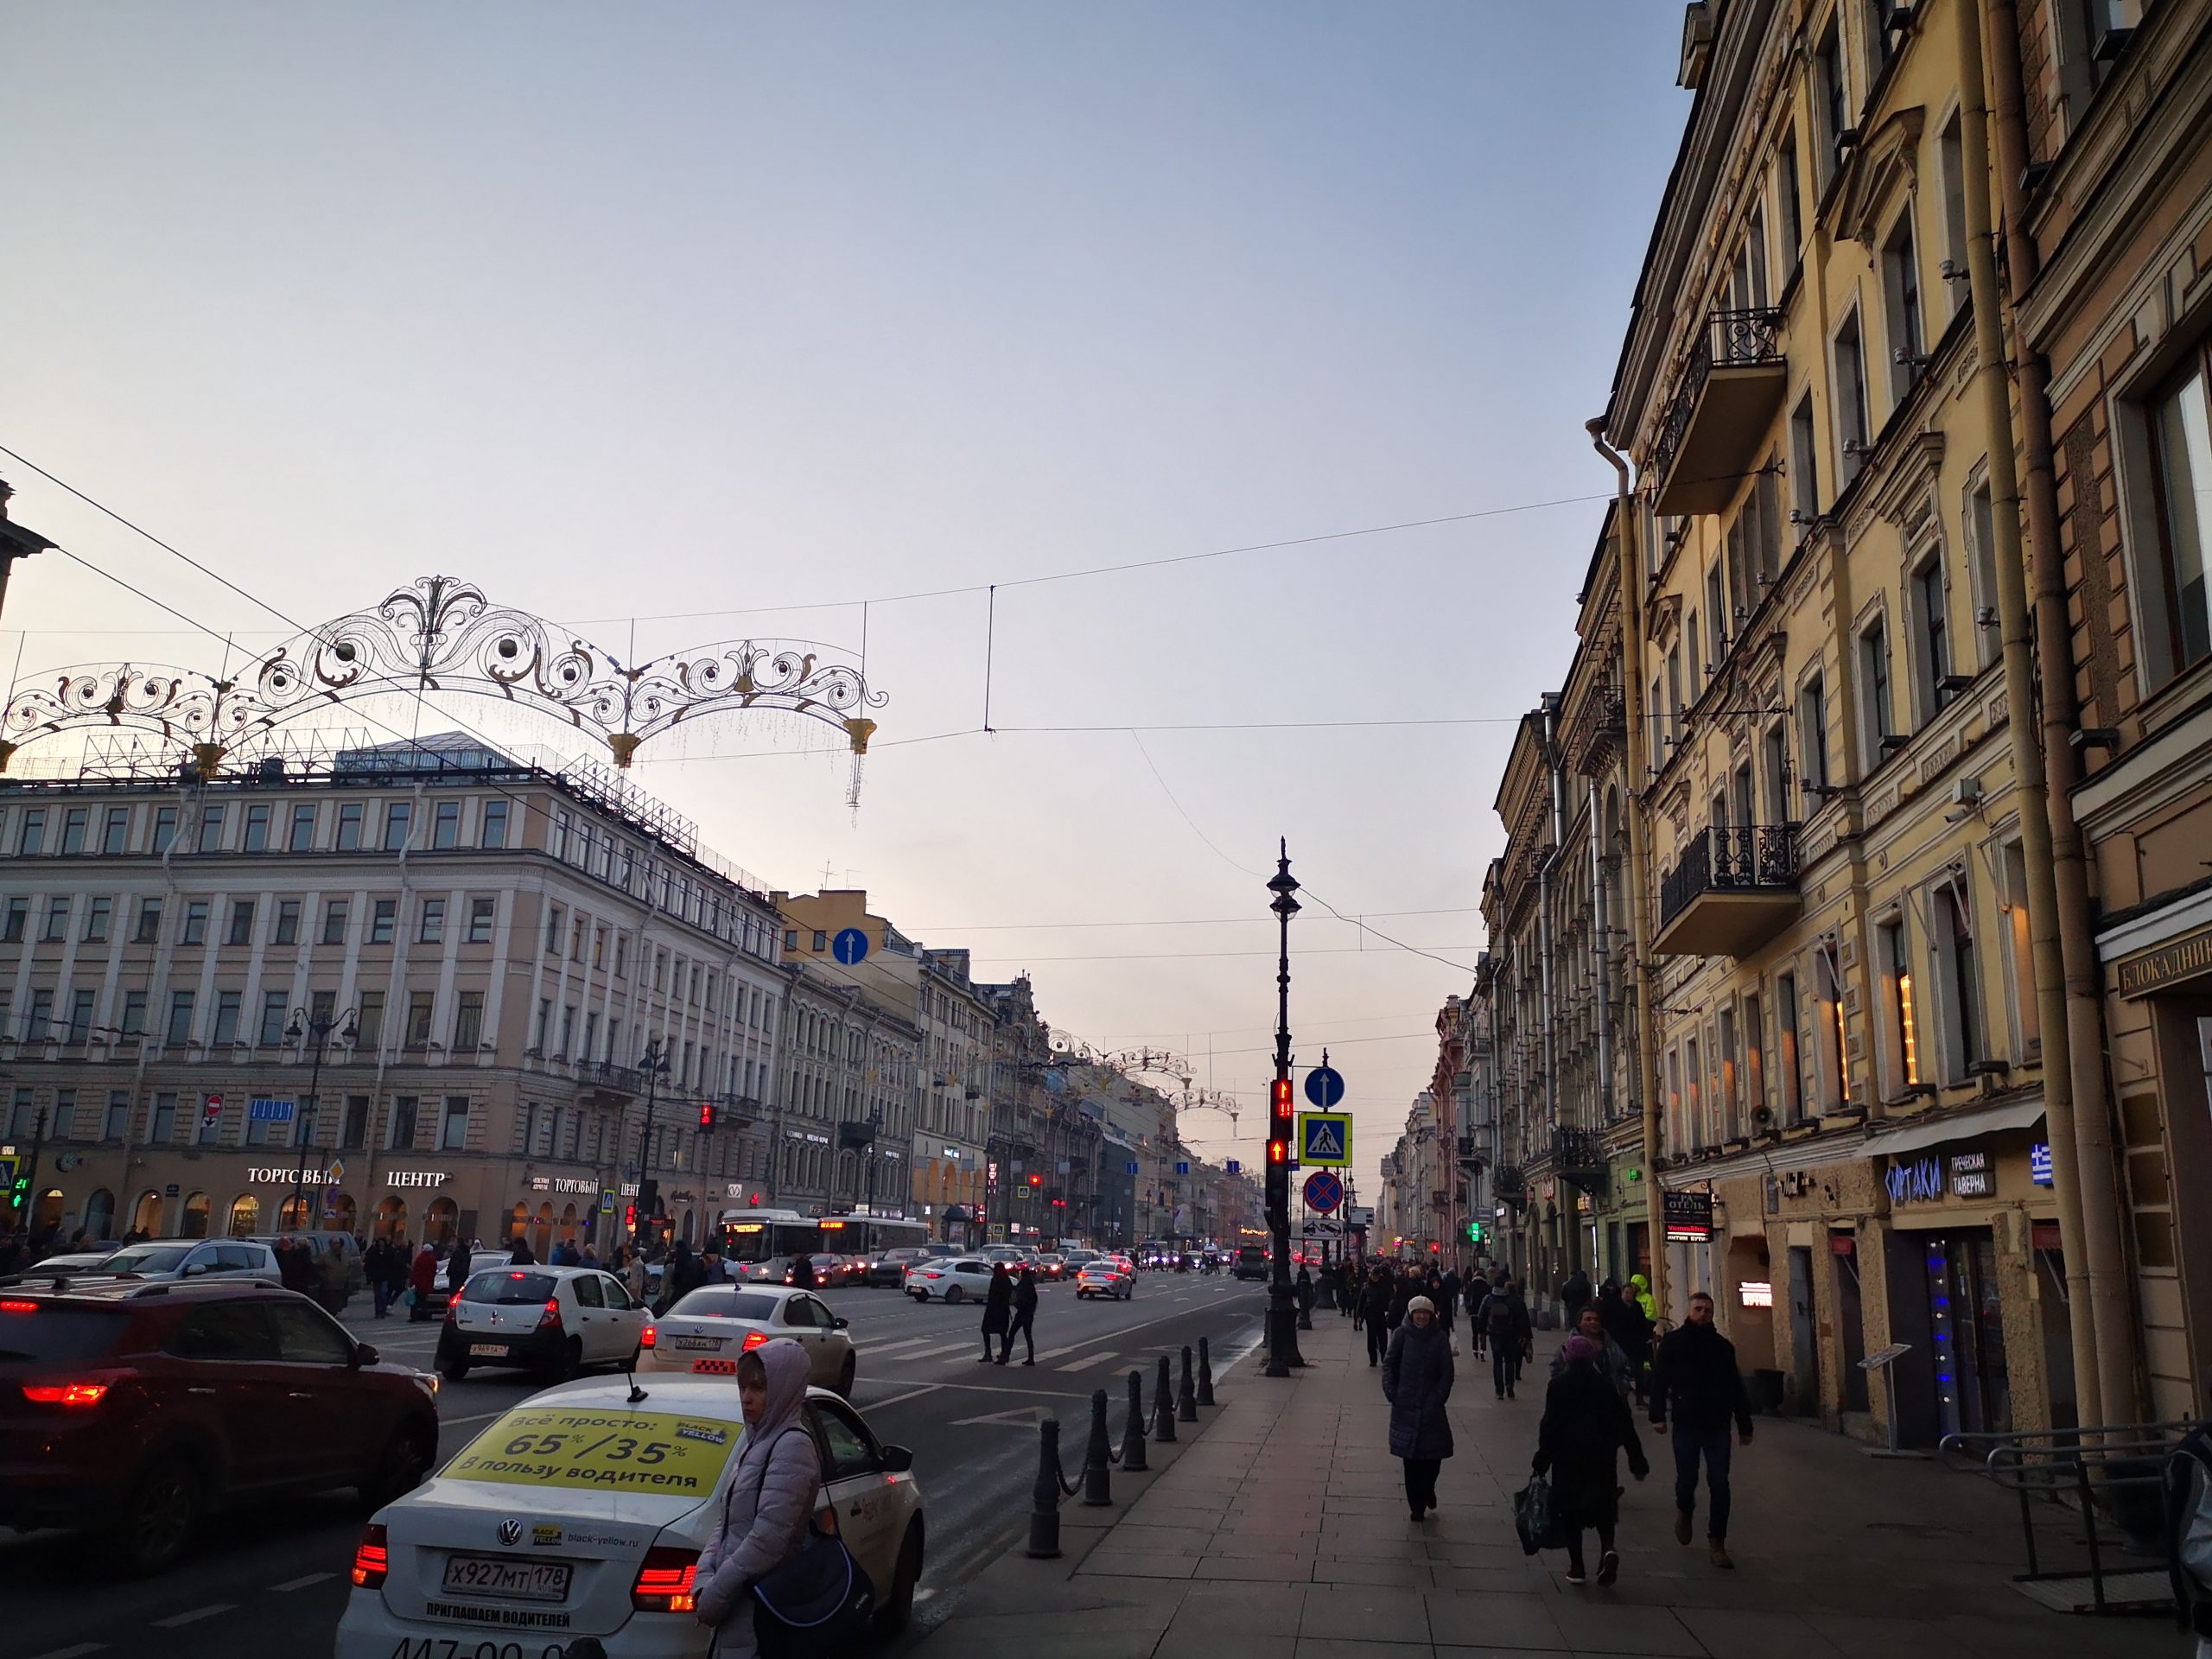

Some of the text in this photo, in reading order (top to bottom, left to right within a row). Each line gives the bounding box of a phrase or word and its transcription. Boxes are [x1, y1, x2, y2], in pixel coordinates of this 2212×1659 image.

[1951, 1153, 1985, 1171] ГРЕЧЕСКАЯ
[387, 1171, 445, 1187] ЦЕНТР
[555, 1178, 640, 1197] ТОРГОВЫЙ ЦЕНТ
[1885, 1154, 1941, 1203] СИРТАКИ
[1953, 1173, 1986, 1195] ТАВЕРНА
[1669, 1201, 1704, 1210] ОТЕЛЬ
[512, 1414, 658, 1431] Всё просто:
[681, 1428, 726, 1444] YELLOW
[459, 1456, 698, 1488] В пользу водителя
[567, 1532, 639, 1548] black-yellow.ru
[426, 1602, 570, 1627] ПРИГЛАШАЕМ ВОДИТЕЛЕЙ
